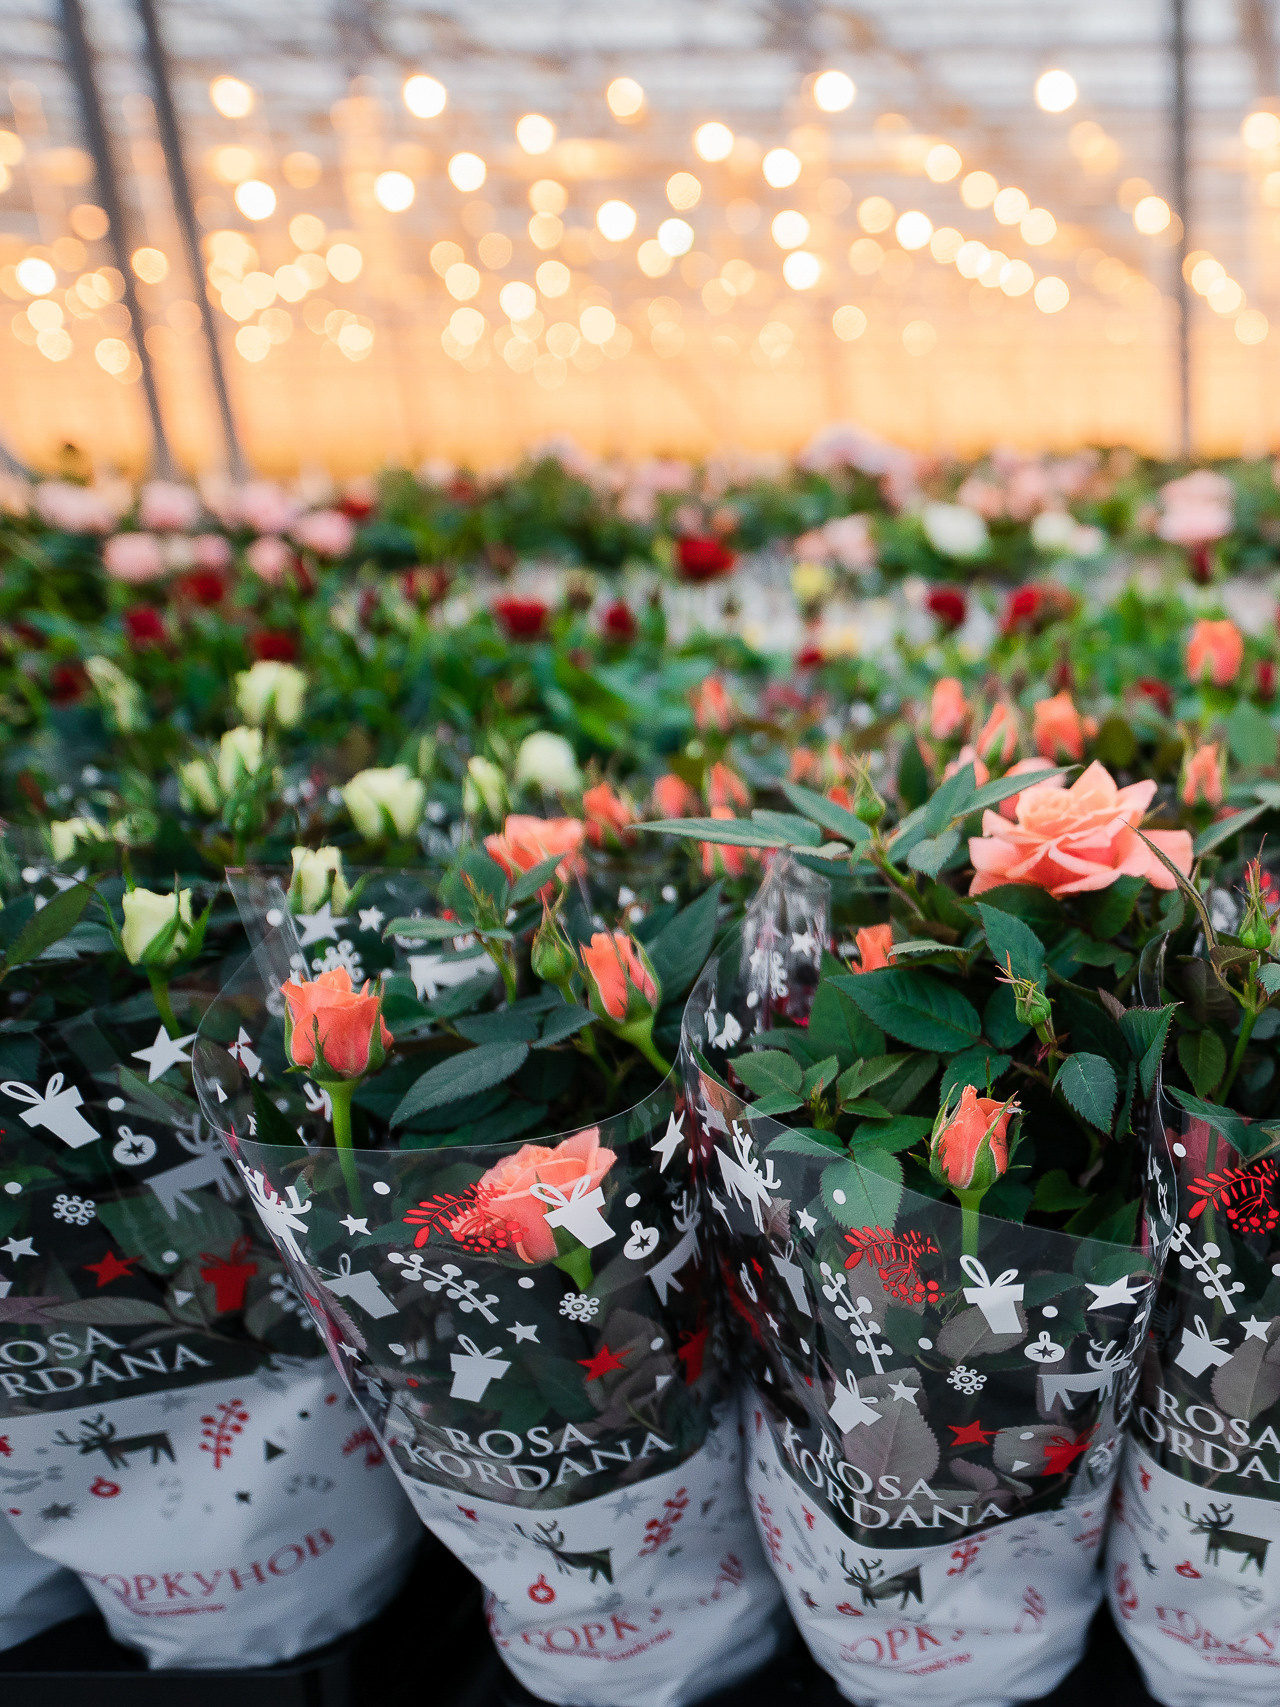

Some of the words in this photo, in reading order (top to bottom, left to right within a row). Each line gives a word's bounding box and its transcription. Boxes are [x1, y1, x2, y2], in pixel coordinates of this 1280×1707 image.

[0, 1326, 126, 1368] OSA
[0, 1343, 213, 1398] RDANA
[400, 1431, 676, 1491] KORDANA
[441, 1422, 599, 1460] ROSA
[817, 1428, 943, 1501] ROSA
[782, 1416, 1012, 1530] KORDANA
[79, 1526, 336, 1602] ОРКУНОВ
